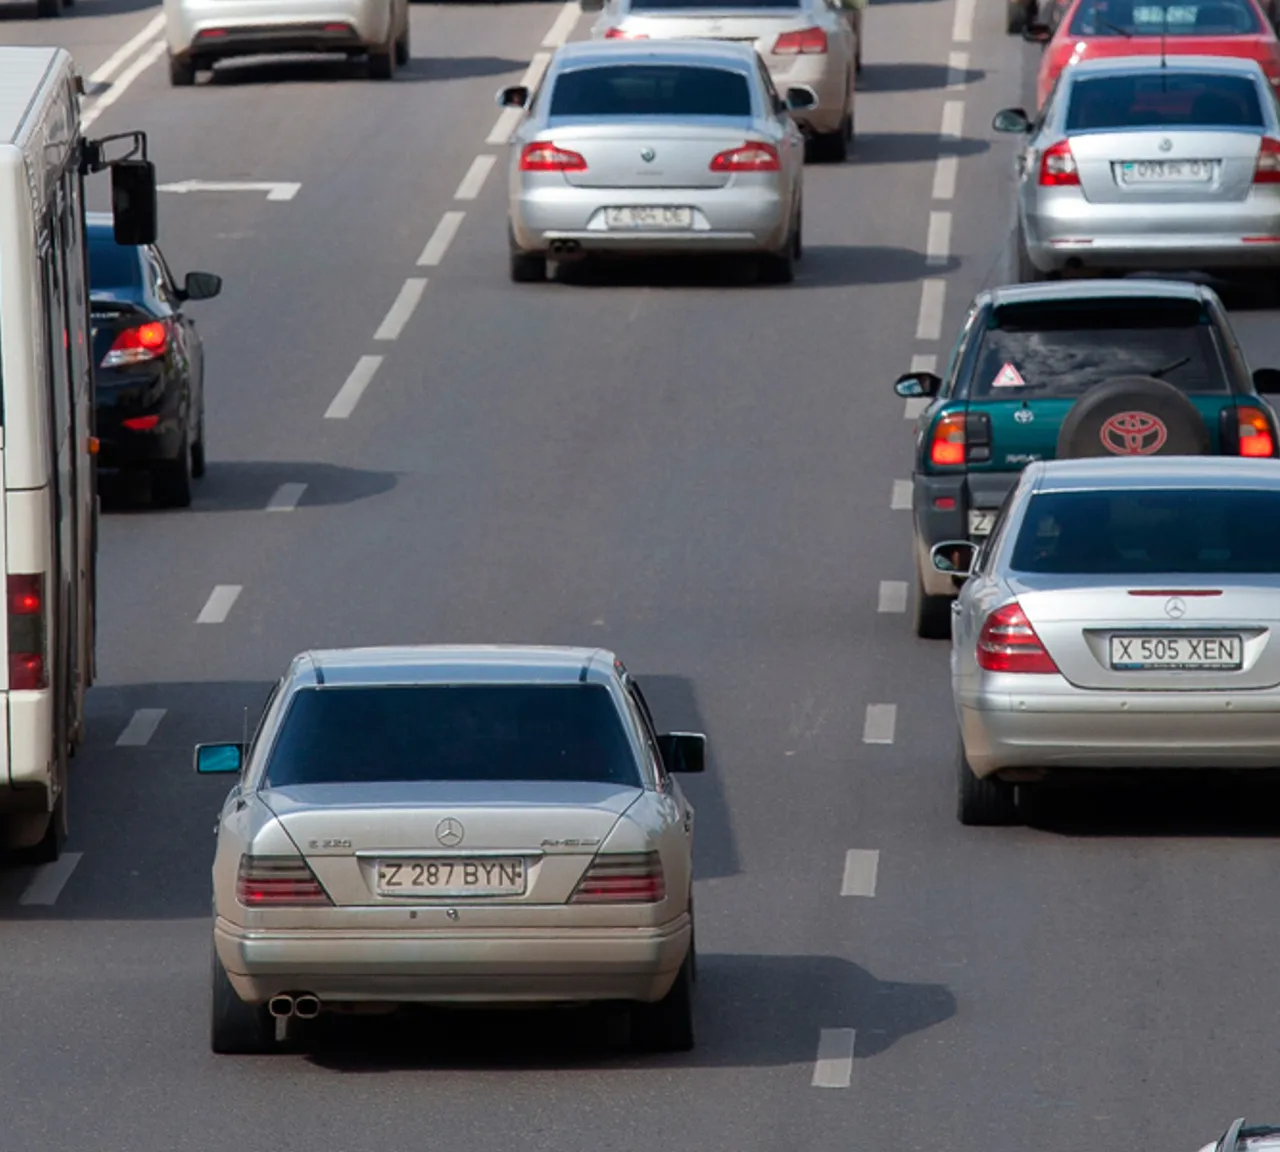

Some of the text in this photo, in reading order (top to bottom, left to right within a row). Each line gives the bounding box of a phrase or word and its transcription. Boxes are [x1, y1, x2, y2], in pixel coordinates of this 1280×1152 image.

[1119, 639, 1234, 660] X 505 XEN
[384, 862, 518, 887] Z 287 BYN
